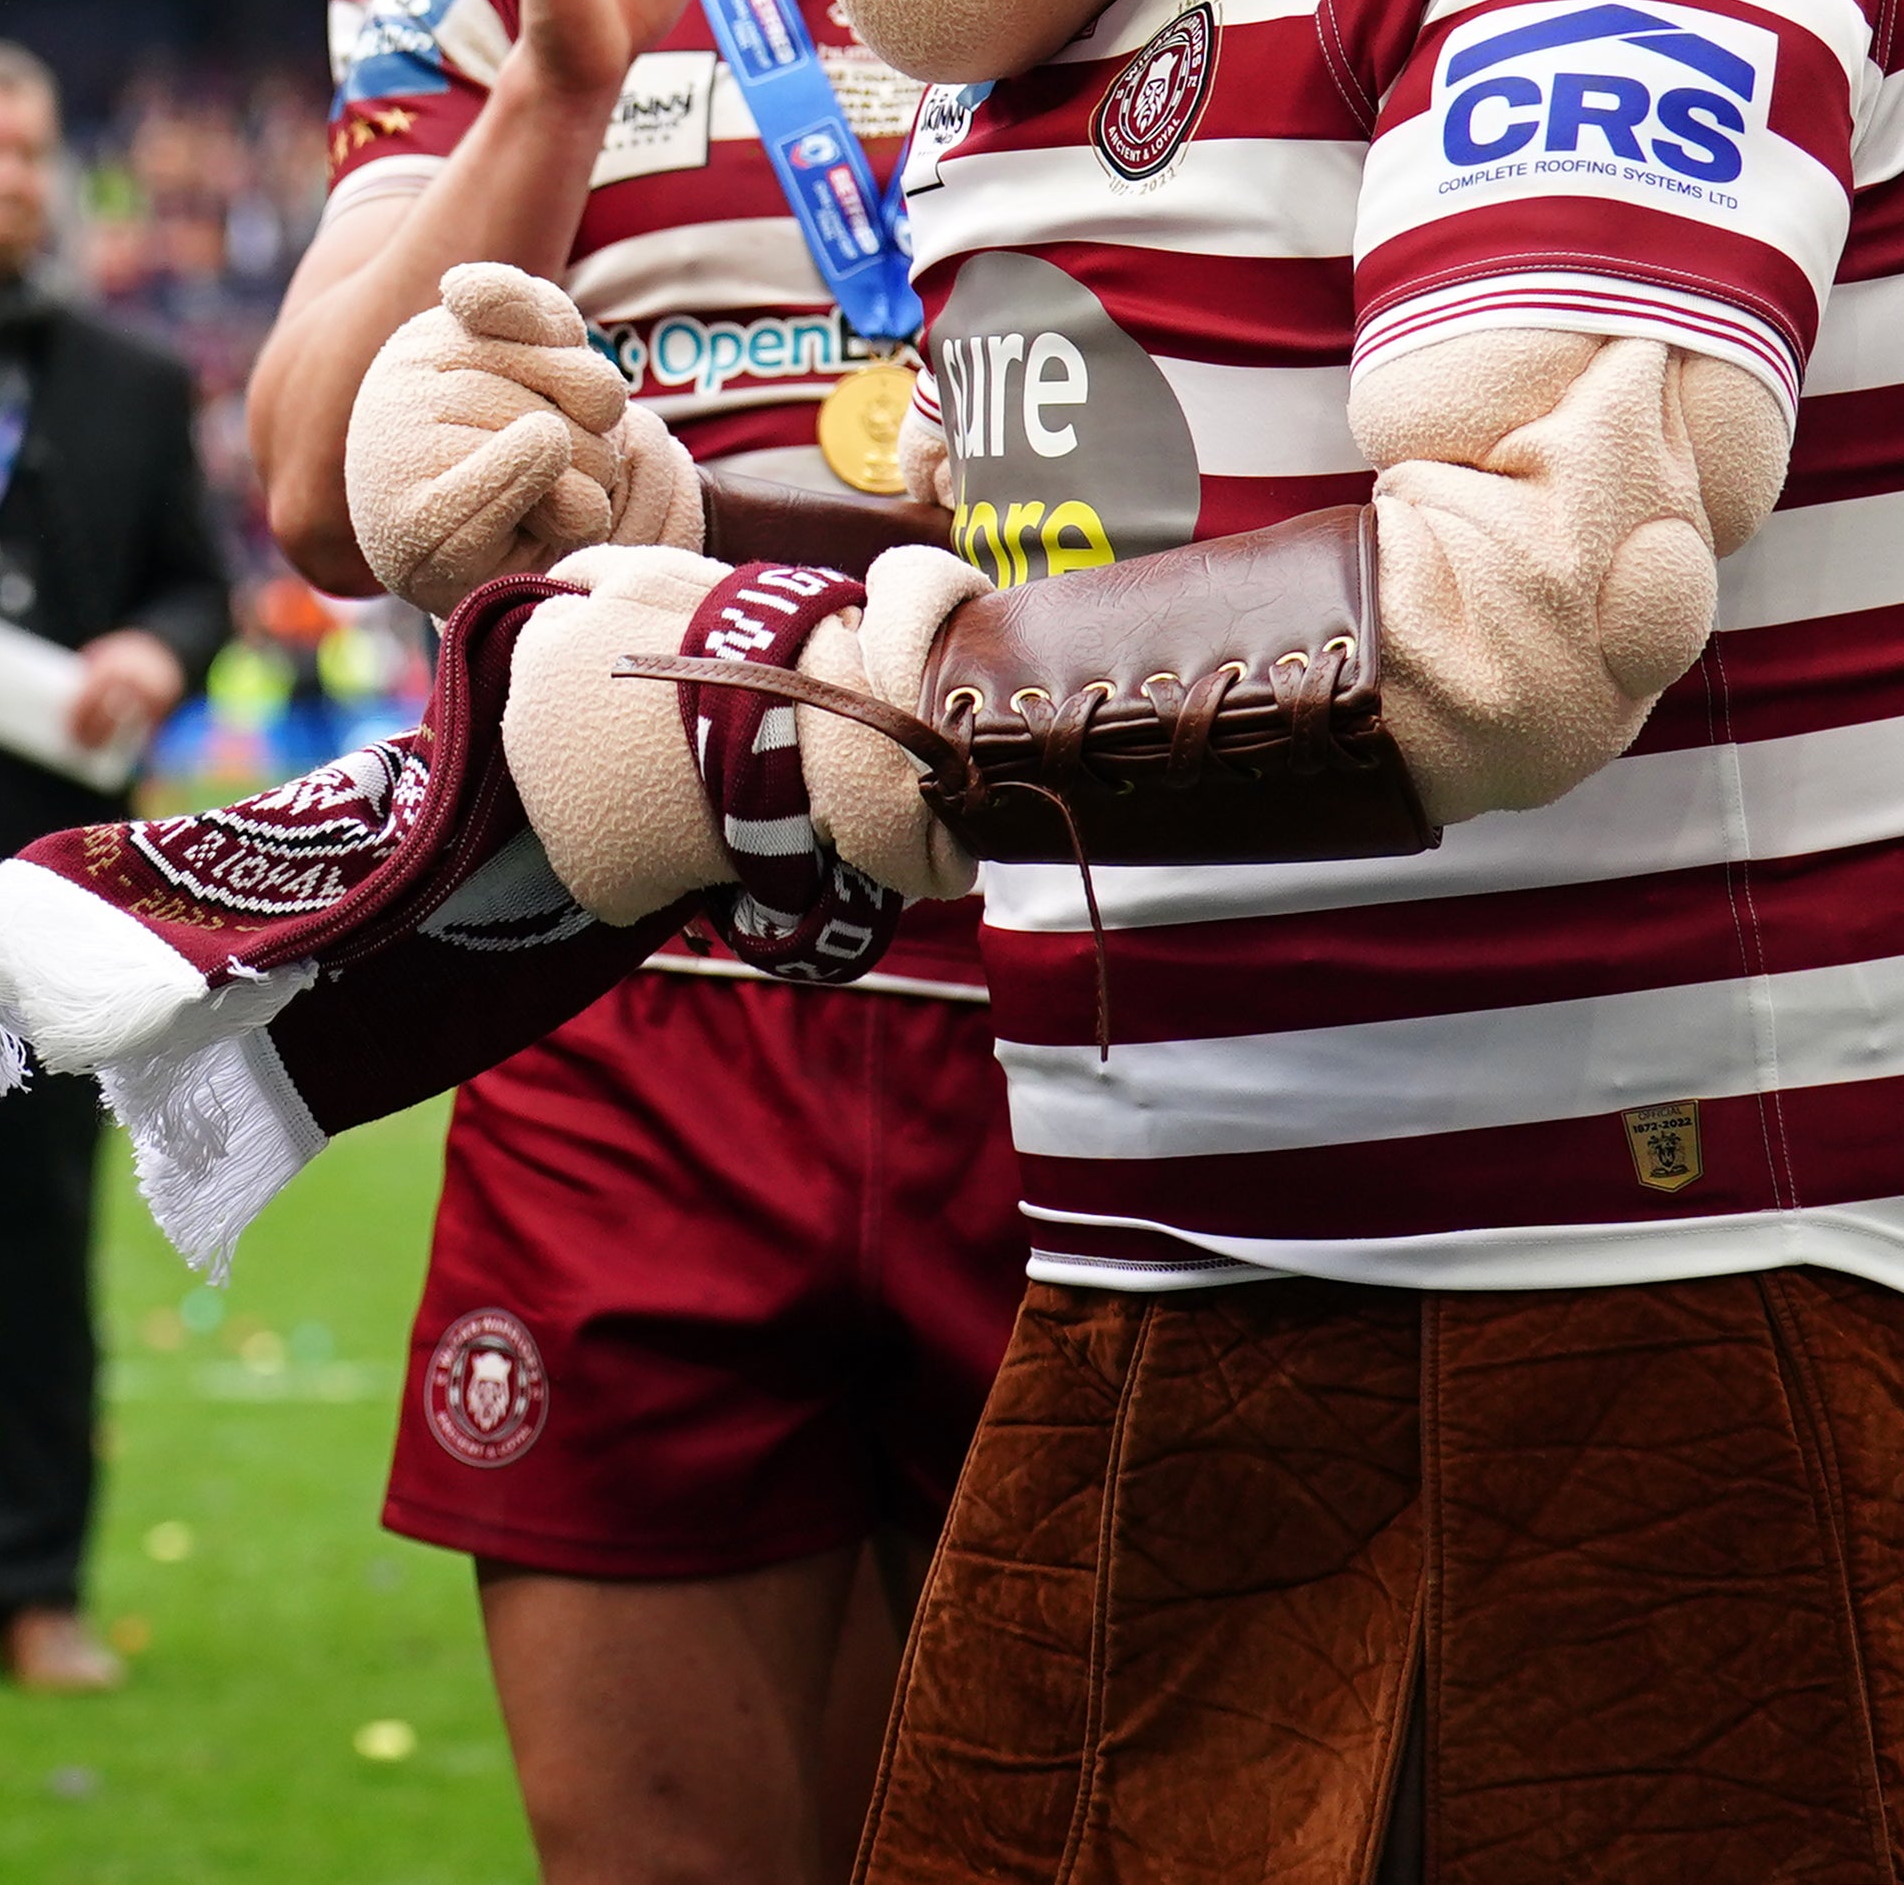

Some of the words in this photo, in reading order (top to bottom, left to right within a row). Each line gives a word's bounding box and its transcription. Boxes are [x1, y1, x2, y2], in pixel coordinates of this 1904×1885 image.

[1108, 125, 1141, 162] ANCIENT
[1150, 118, 1181, 155] LOYAL
[1443, 72, 1746, 184] CRS
[1438, 162, 1528, 195] COMPLETE
[1534, 159, 1617, 177] ROOFING
[1623, 167, 1703, 199] SYSTEMS
[1709, 190, 1738, 210] LTD
[942, 331, 1089, 459] sure
[1632, 1117, 1692, 1134] 1872-2022
